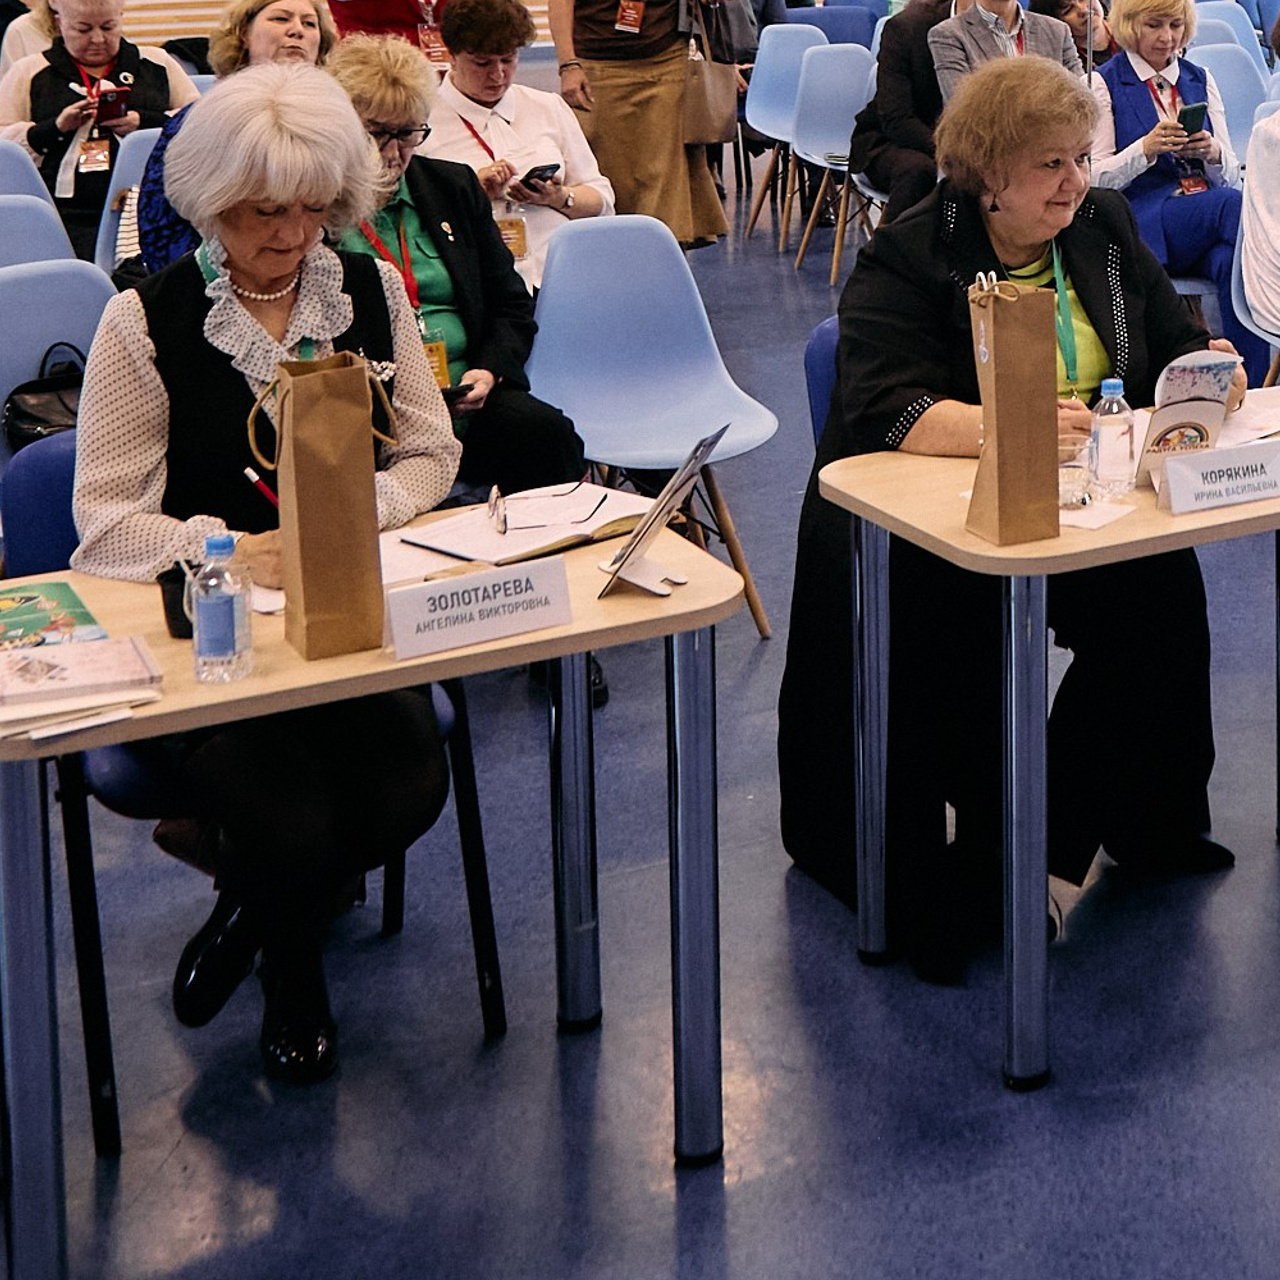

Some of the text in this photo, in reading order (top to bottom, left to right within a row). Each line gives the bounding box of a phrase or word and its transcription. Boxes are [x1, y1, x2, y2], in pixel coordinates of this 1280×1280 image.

[1201, 462, 1268, 486] КОРЯКИНА
[1194, 480, 1278, 502] ИРИНА ВАСИЛЬЕВНА
[427, 577, 534, 613] ЗОЛОТАРЕВА
[415, 596, 551, 634] АНГЕЛИНА ВИКТОРОВНА
